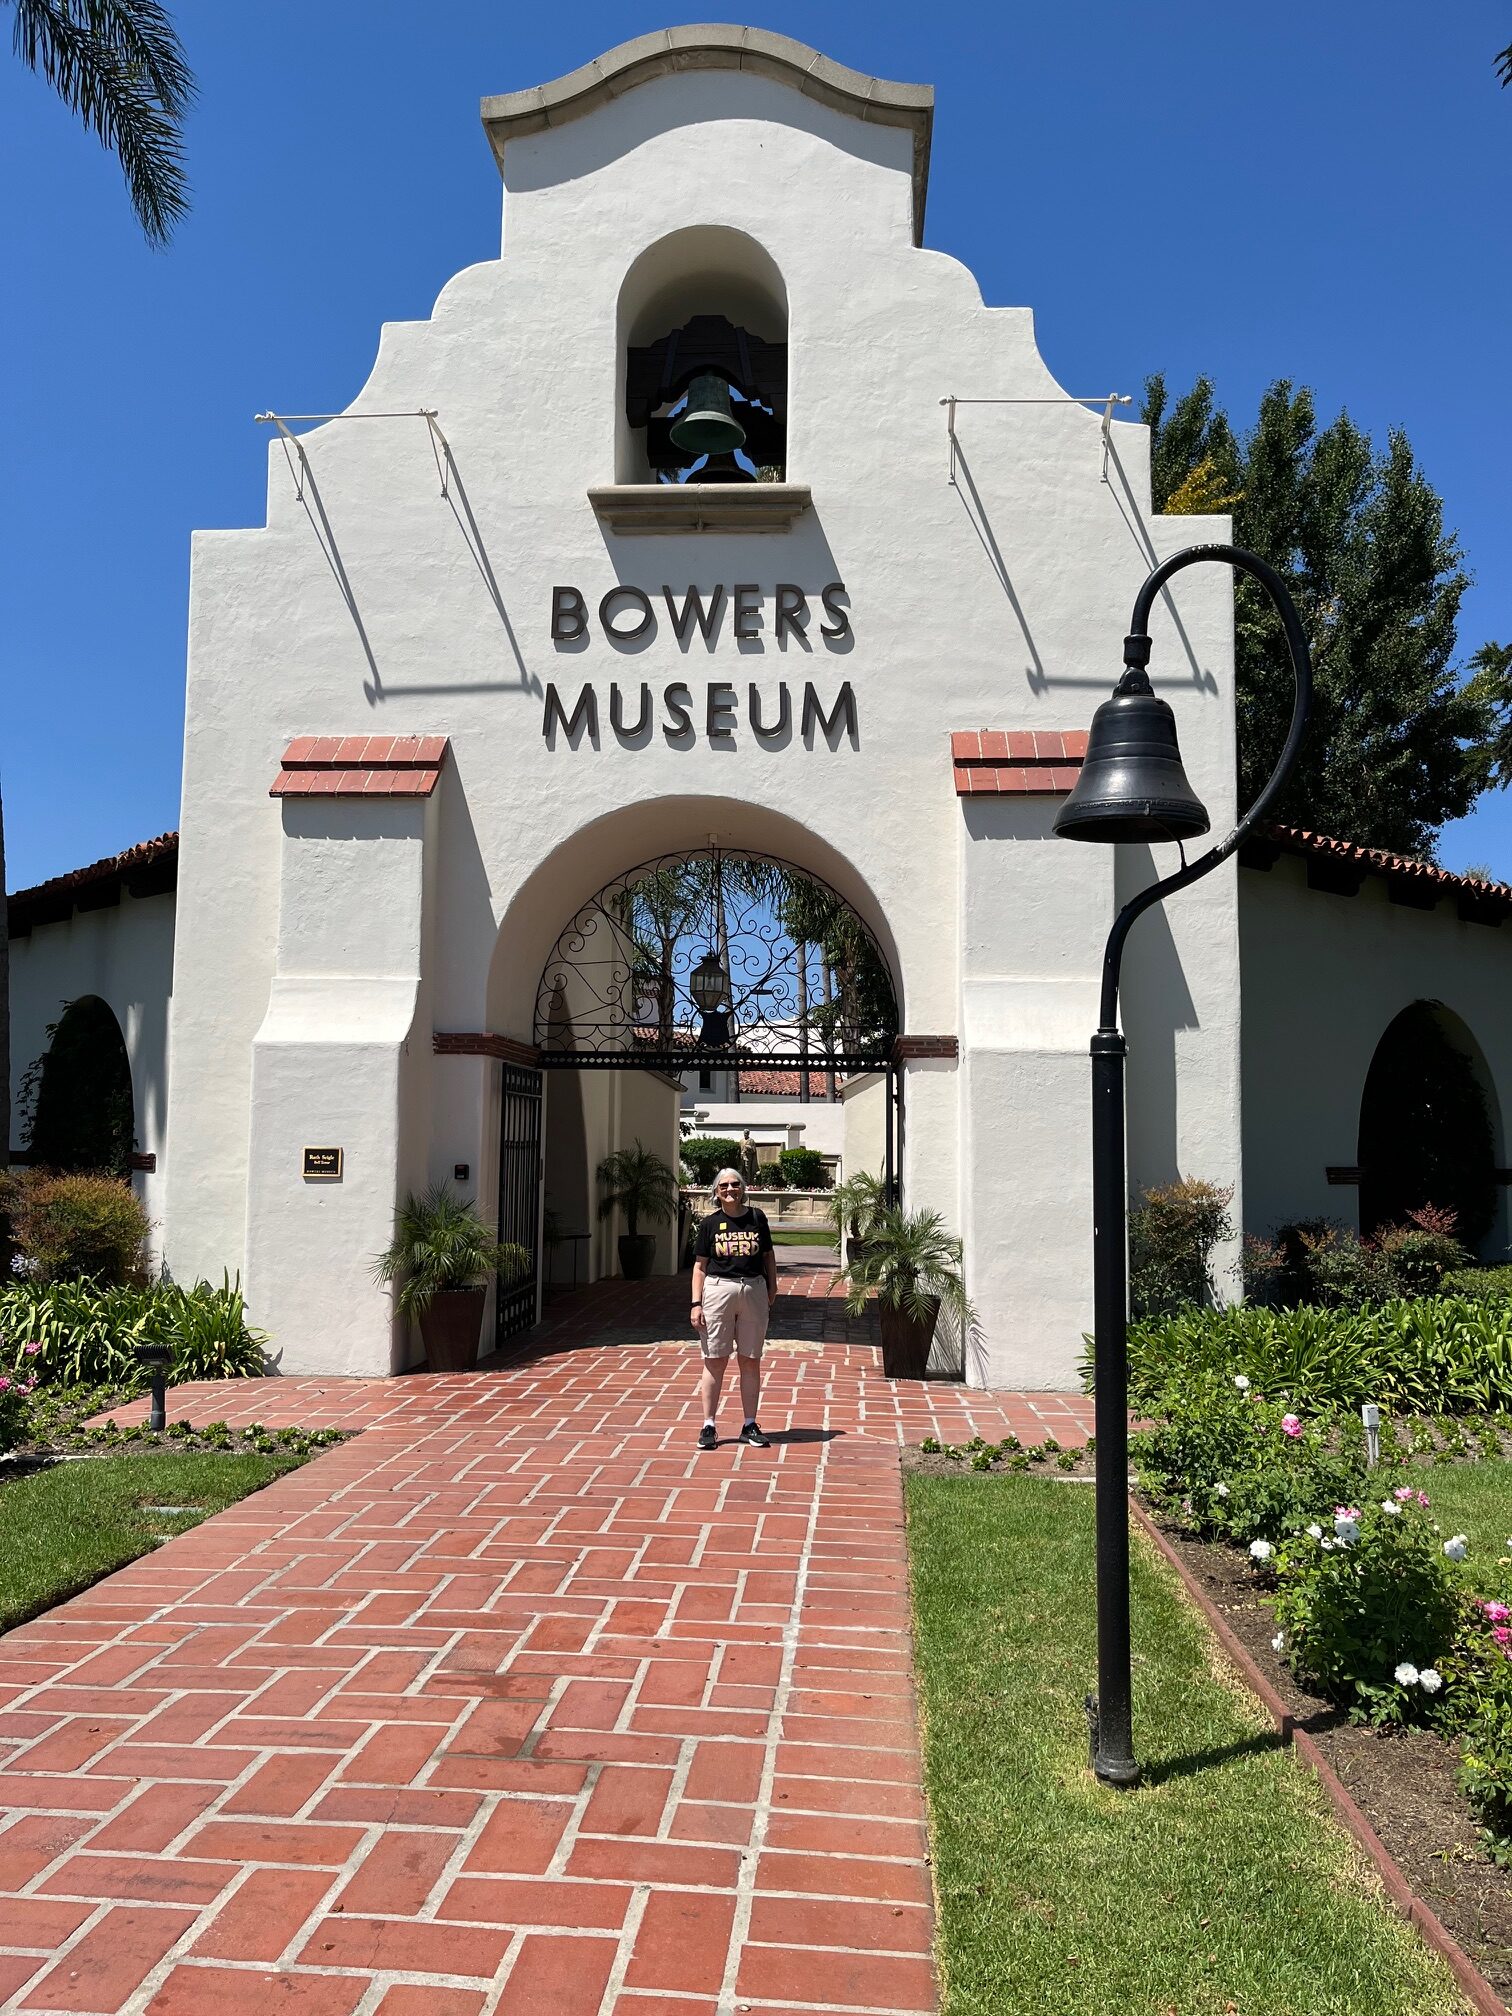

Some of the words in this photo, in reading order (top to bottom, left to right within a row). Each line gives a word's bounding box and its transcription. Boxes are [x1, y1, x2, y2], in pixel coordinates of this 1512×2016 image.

[551, 582, 850, 640] BOWERS
[542, 681, 856, 738] MUSEUM
[714, 1231, 760, 1242] MUSEUM
[715, 1241, 760, 1257] NERD
